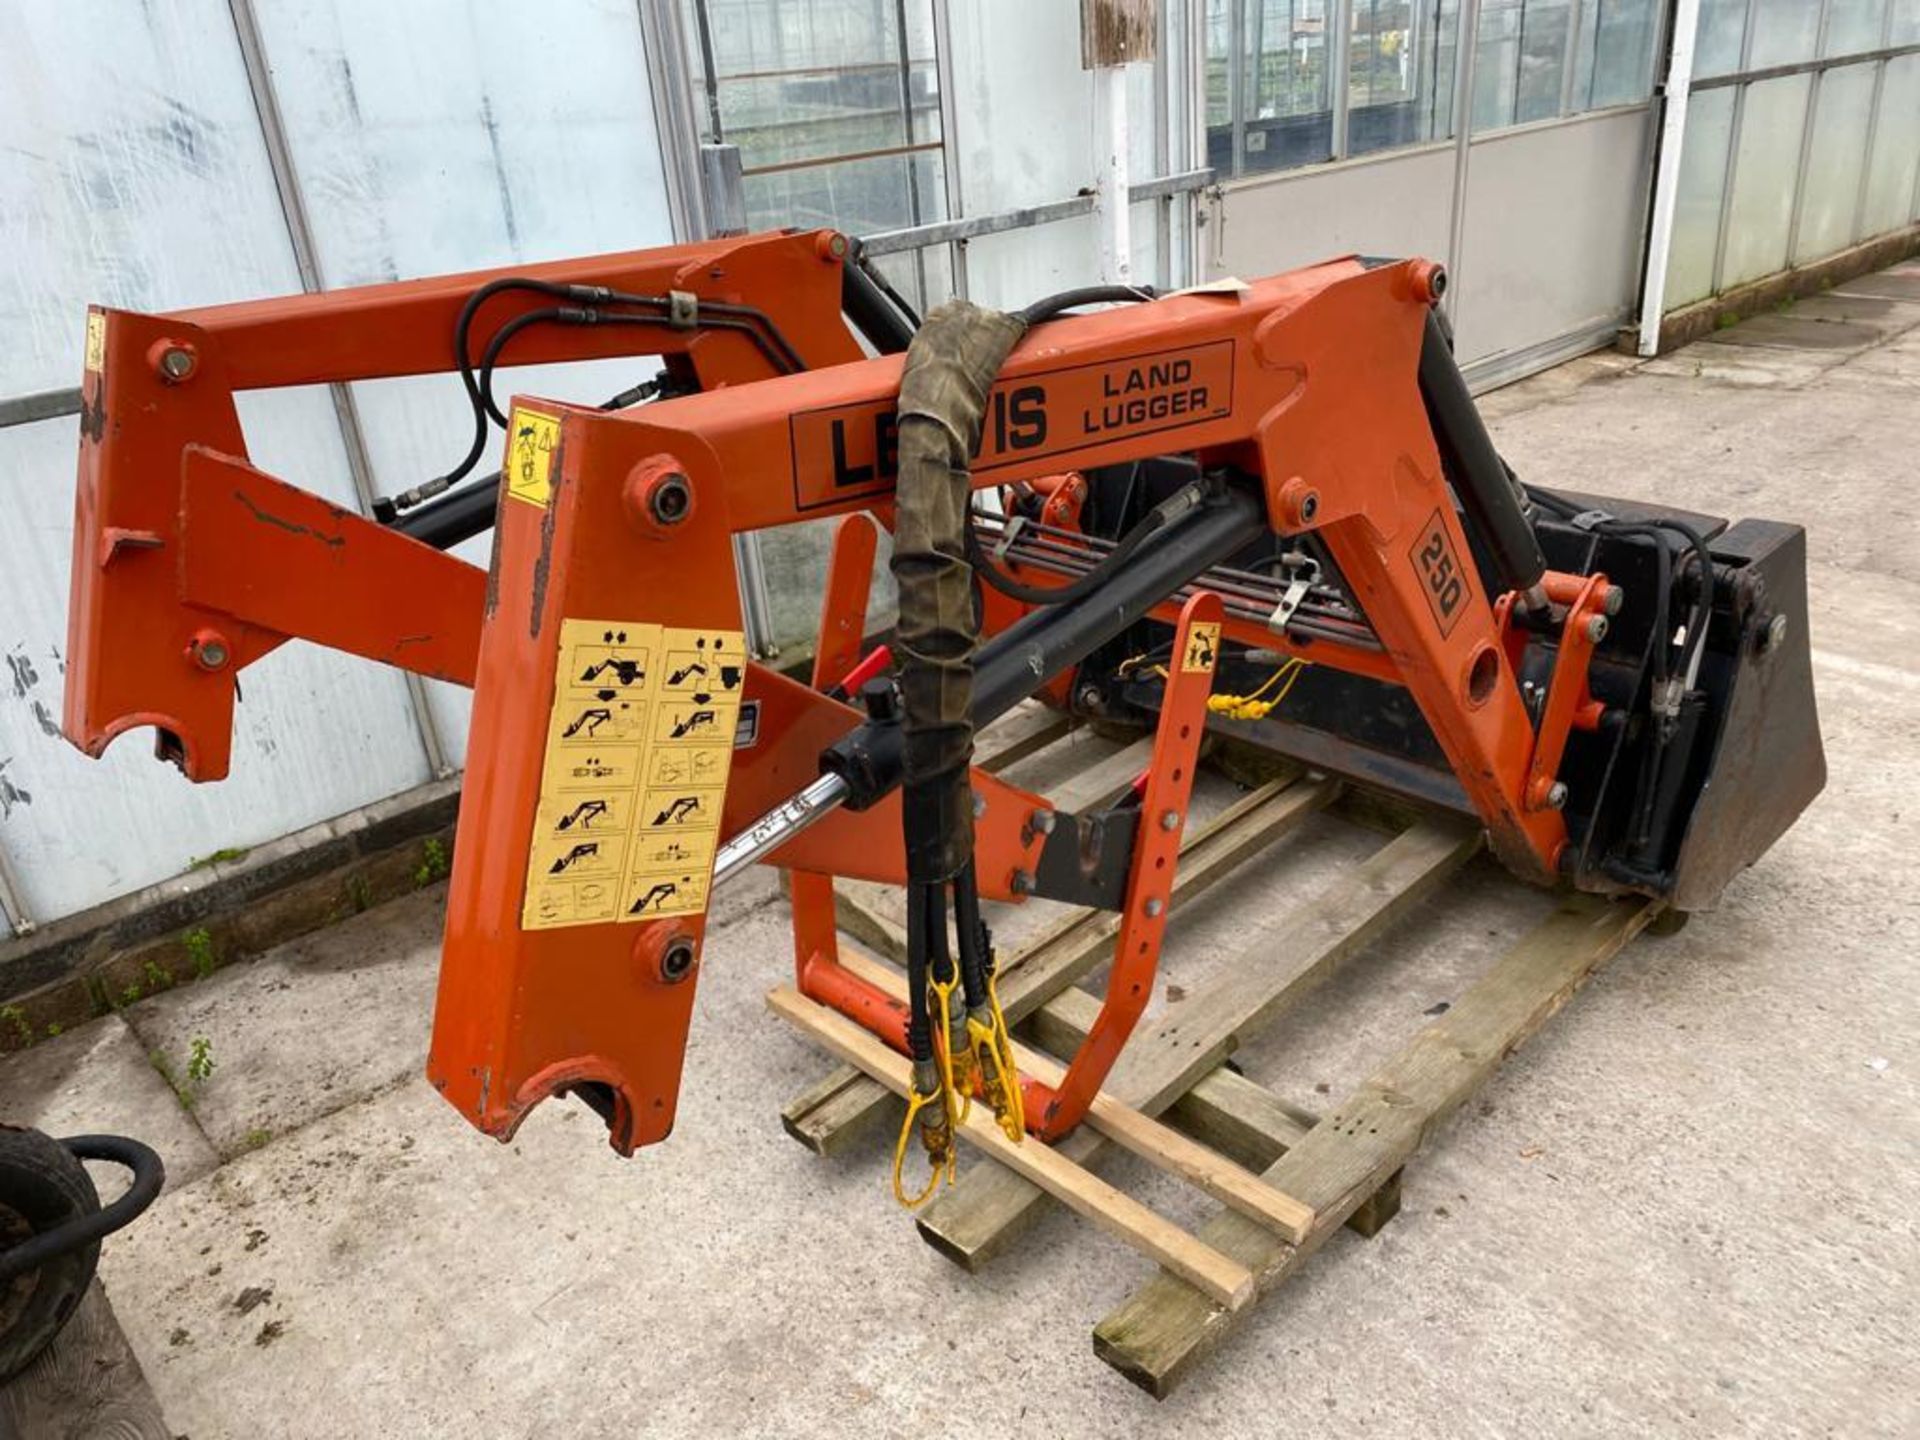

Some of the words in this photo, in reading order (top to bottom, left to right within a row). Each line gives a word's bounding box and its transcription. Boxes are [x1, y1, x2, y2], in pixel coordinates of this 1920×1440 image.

[1084, 387, 1208, 434] LUGGER
[1104, 359, 1192, 398] LAND
[832, 386, 1047, 488] LEIS
[1420, 532, 1461, 619] 250
